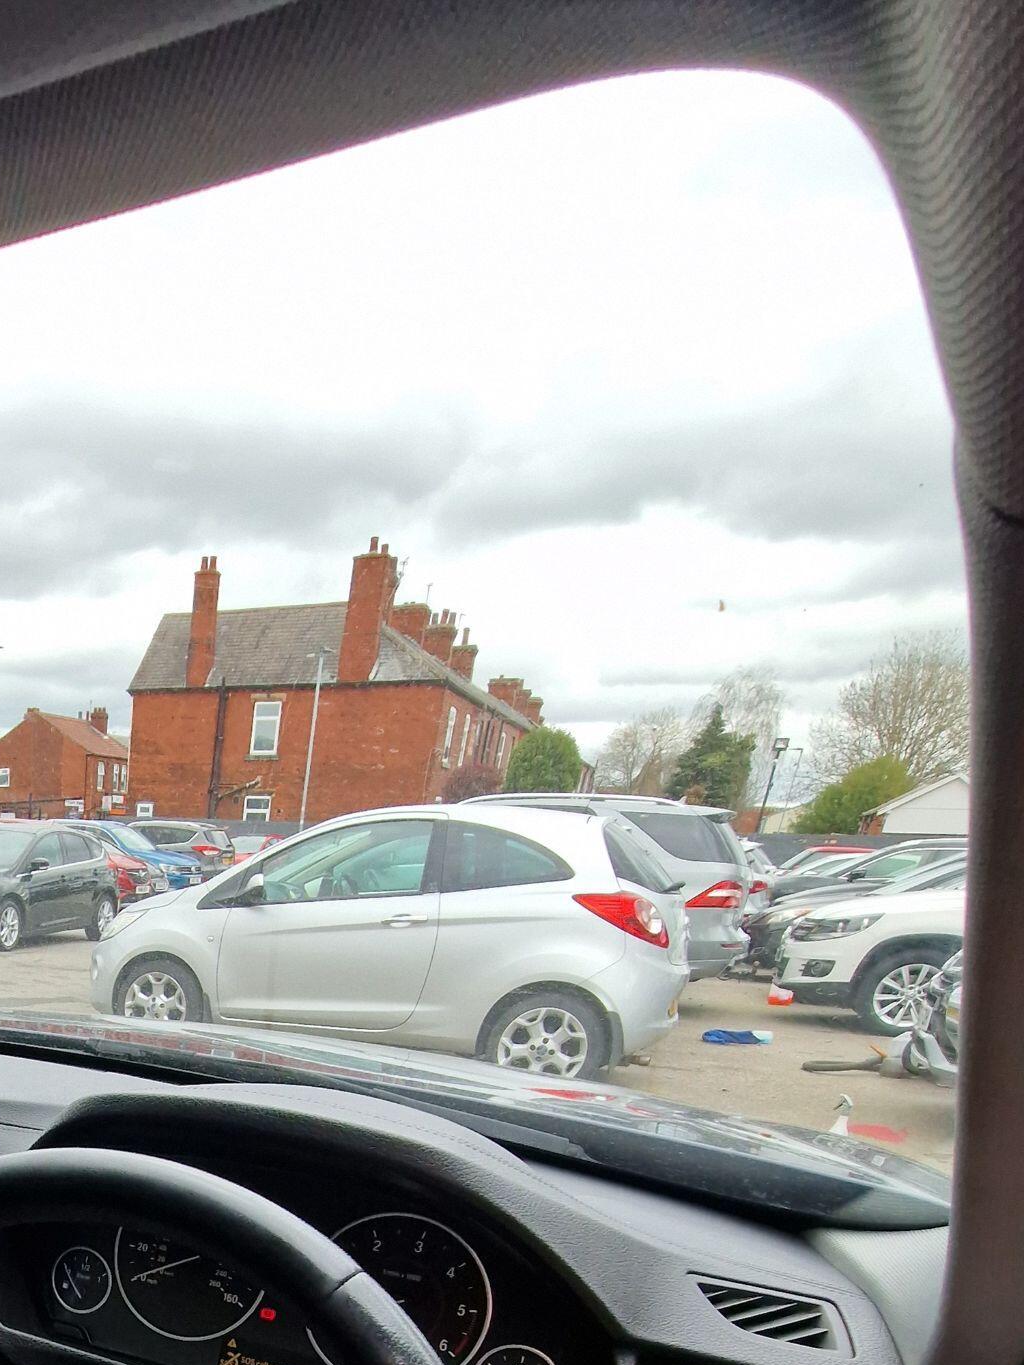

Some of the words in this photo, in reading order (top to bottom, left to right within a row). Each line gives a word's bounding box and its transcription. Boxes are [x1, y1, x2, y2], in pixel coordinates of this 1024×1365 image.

[137, 1242, 148, 1252] 20
[372, 1240, 381, 1251] 2
[414, 1241, 423, 1253] 3
[82, 1263, 91, 1272] 1/2
[446, 1268, 455, 1278] 4
[223, 1293, 238, 1304] 160
[457, 1304, 466, 1316] 5
[439, 1339, 448, 1351] 6
[241, 1357, 255, 1365] SOS
